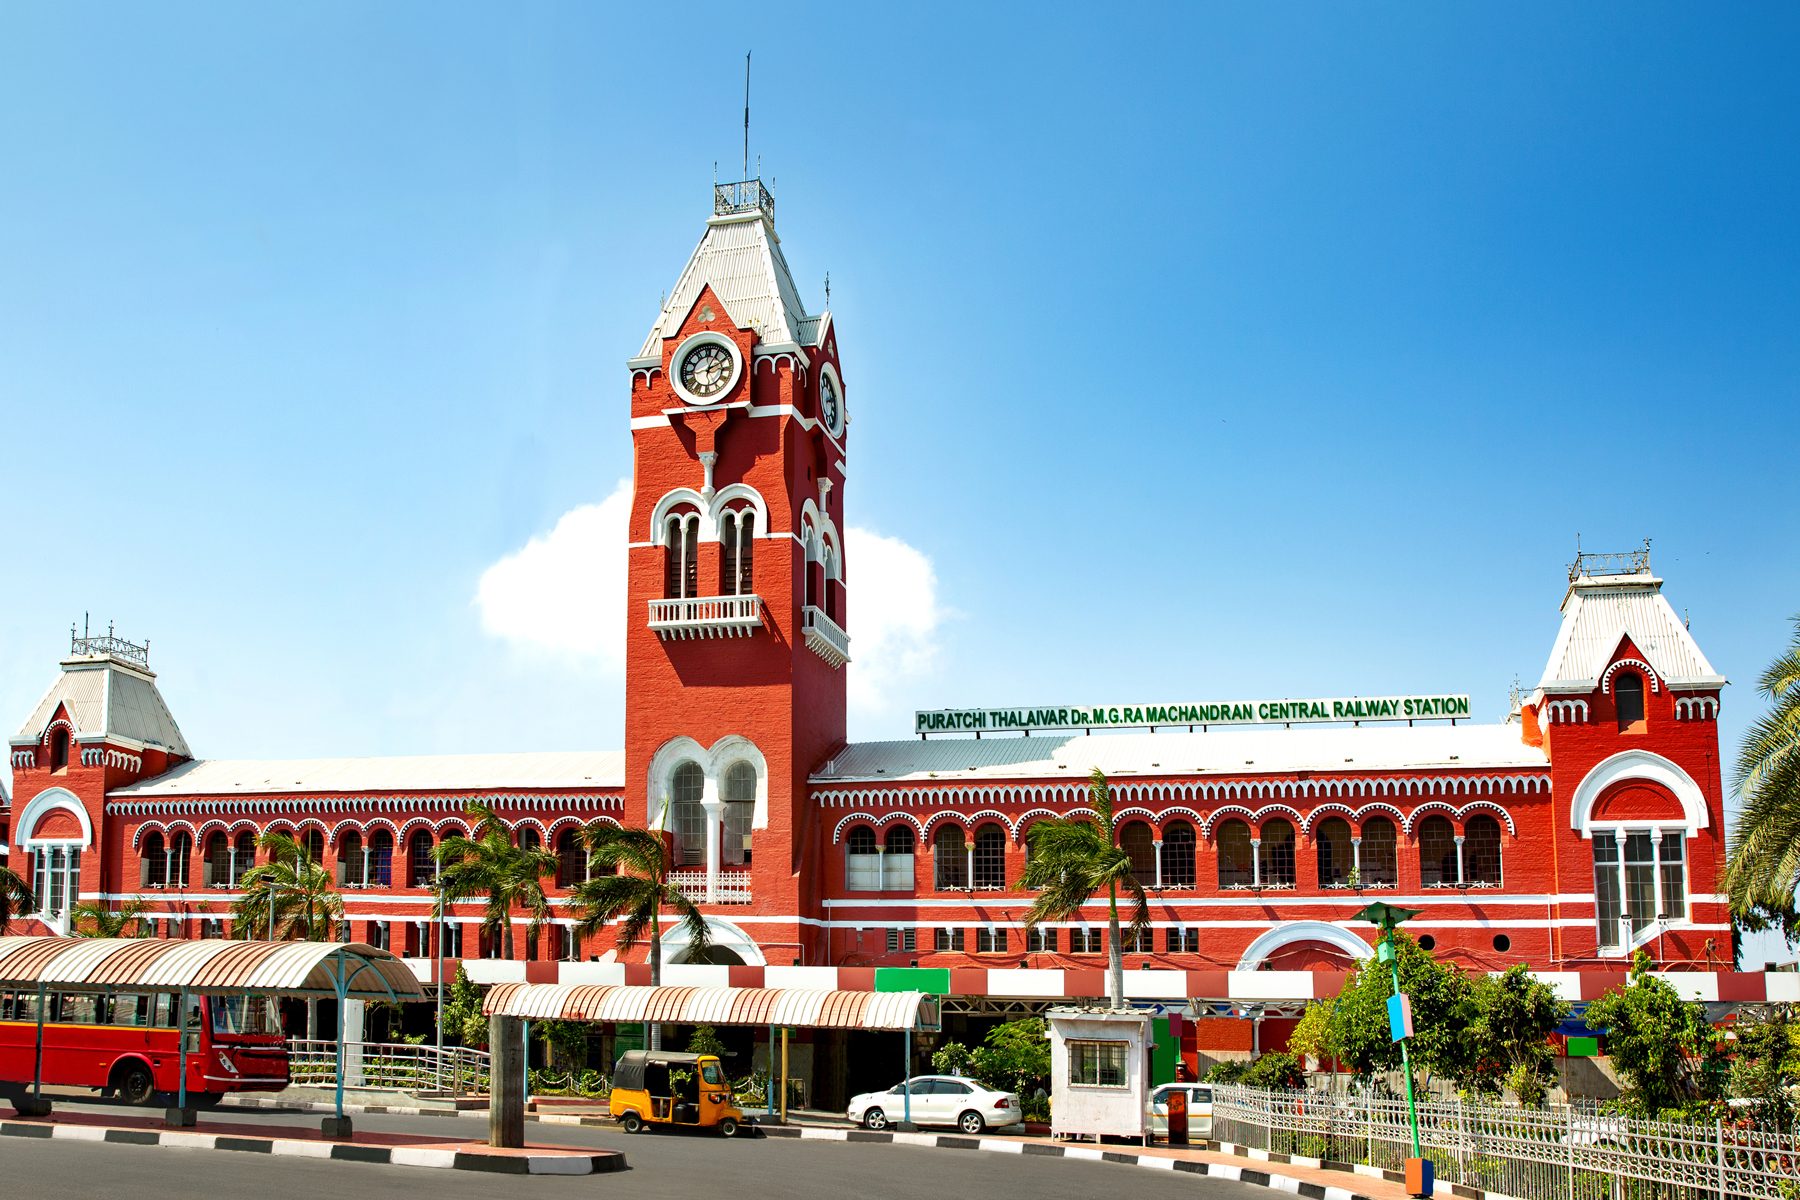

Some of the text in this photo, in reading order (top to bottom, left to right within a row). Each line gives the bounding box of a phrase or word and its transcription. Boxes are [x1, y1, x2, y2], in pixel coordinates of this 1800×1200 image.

[918, 711, 987, 729] PURATCHI
[990, 709, 1069, 727] THALAIVAR
[1258, 702, 1330, 719] CENTRAL
[1333, 700, 1399, 717] RAILWAY
[1403, 697, 1469, 715] STATION
